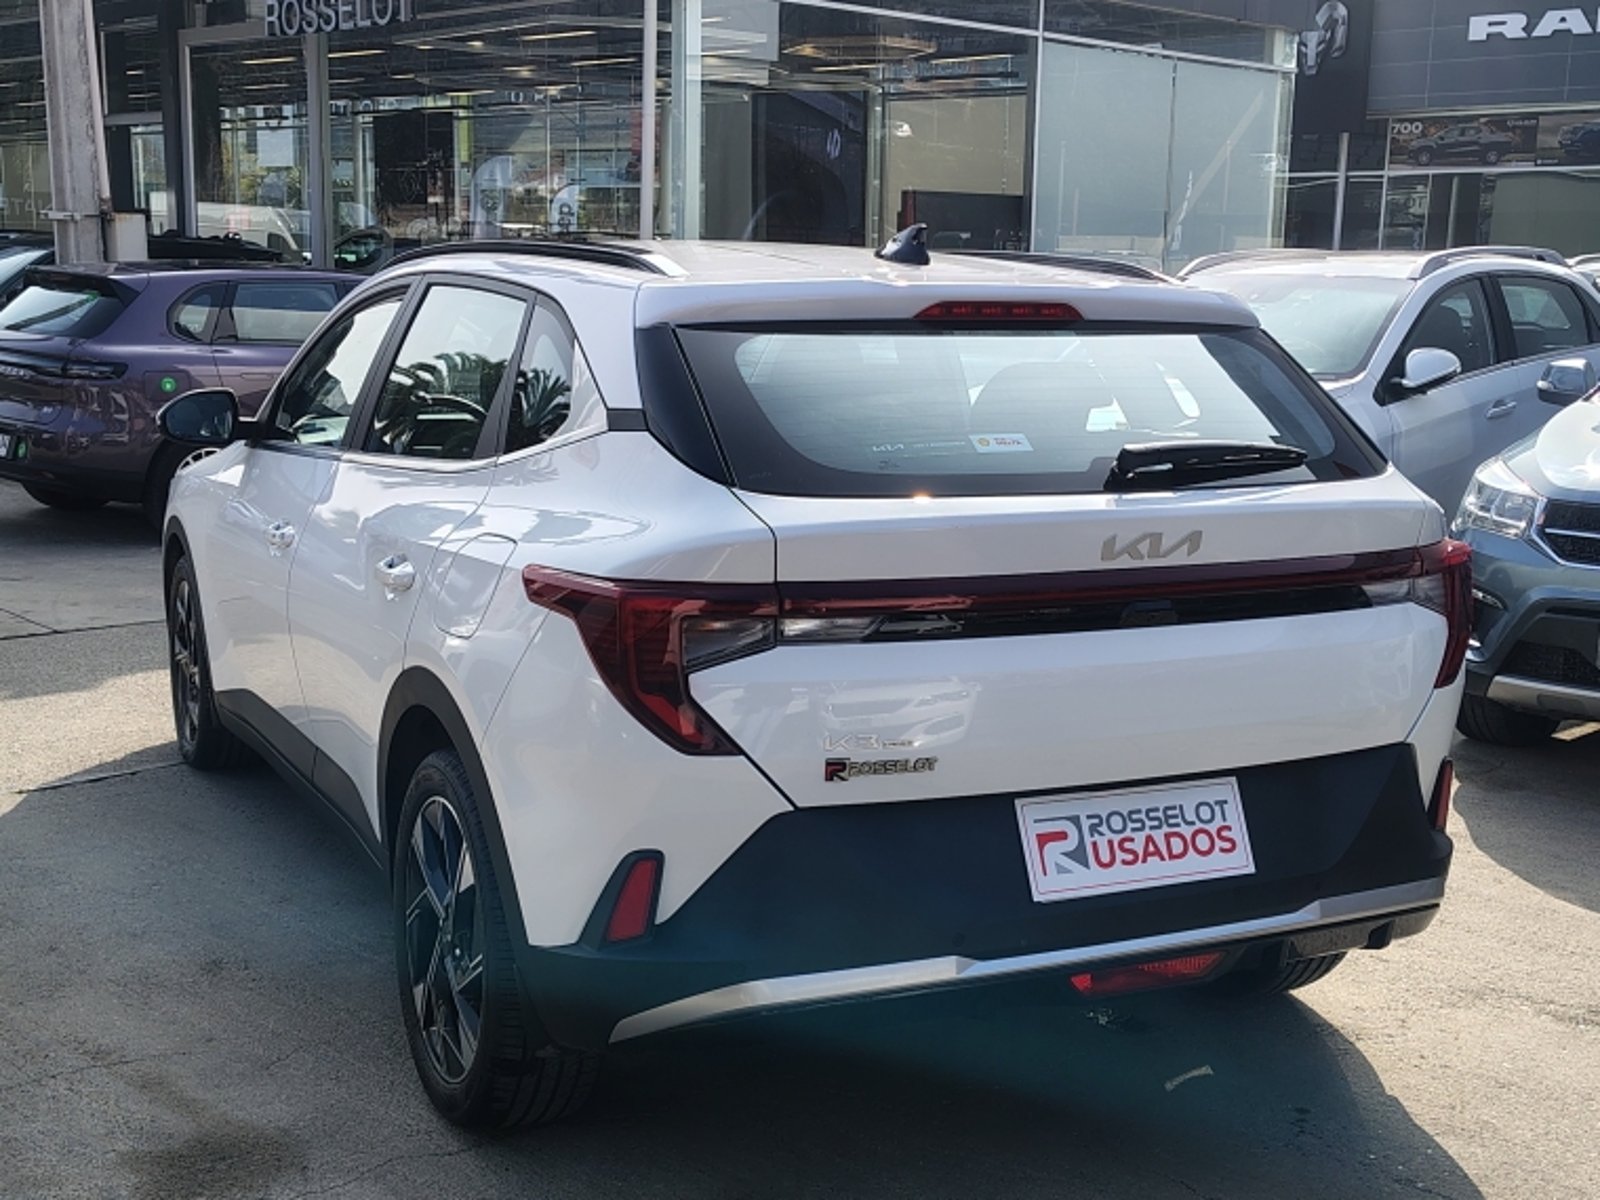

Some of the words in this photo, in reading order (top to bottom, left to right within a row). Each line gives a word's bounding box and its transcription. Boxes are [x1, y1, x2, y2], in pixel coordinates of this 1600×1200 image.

[1468, 8, 1600, 41] RA
[1392, 121, 1423, 134] 700
[1101, 530, 1203, 561] KIA
[1086, 800, 1228, 838] ROSSELOT
[1091, 825, 1237, 870] USADOS
